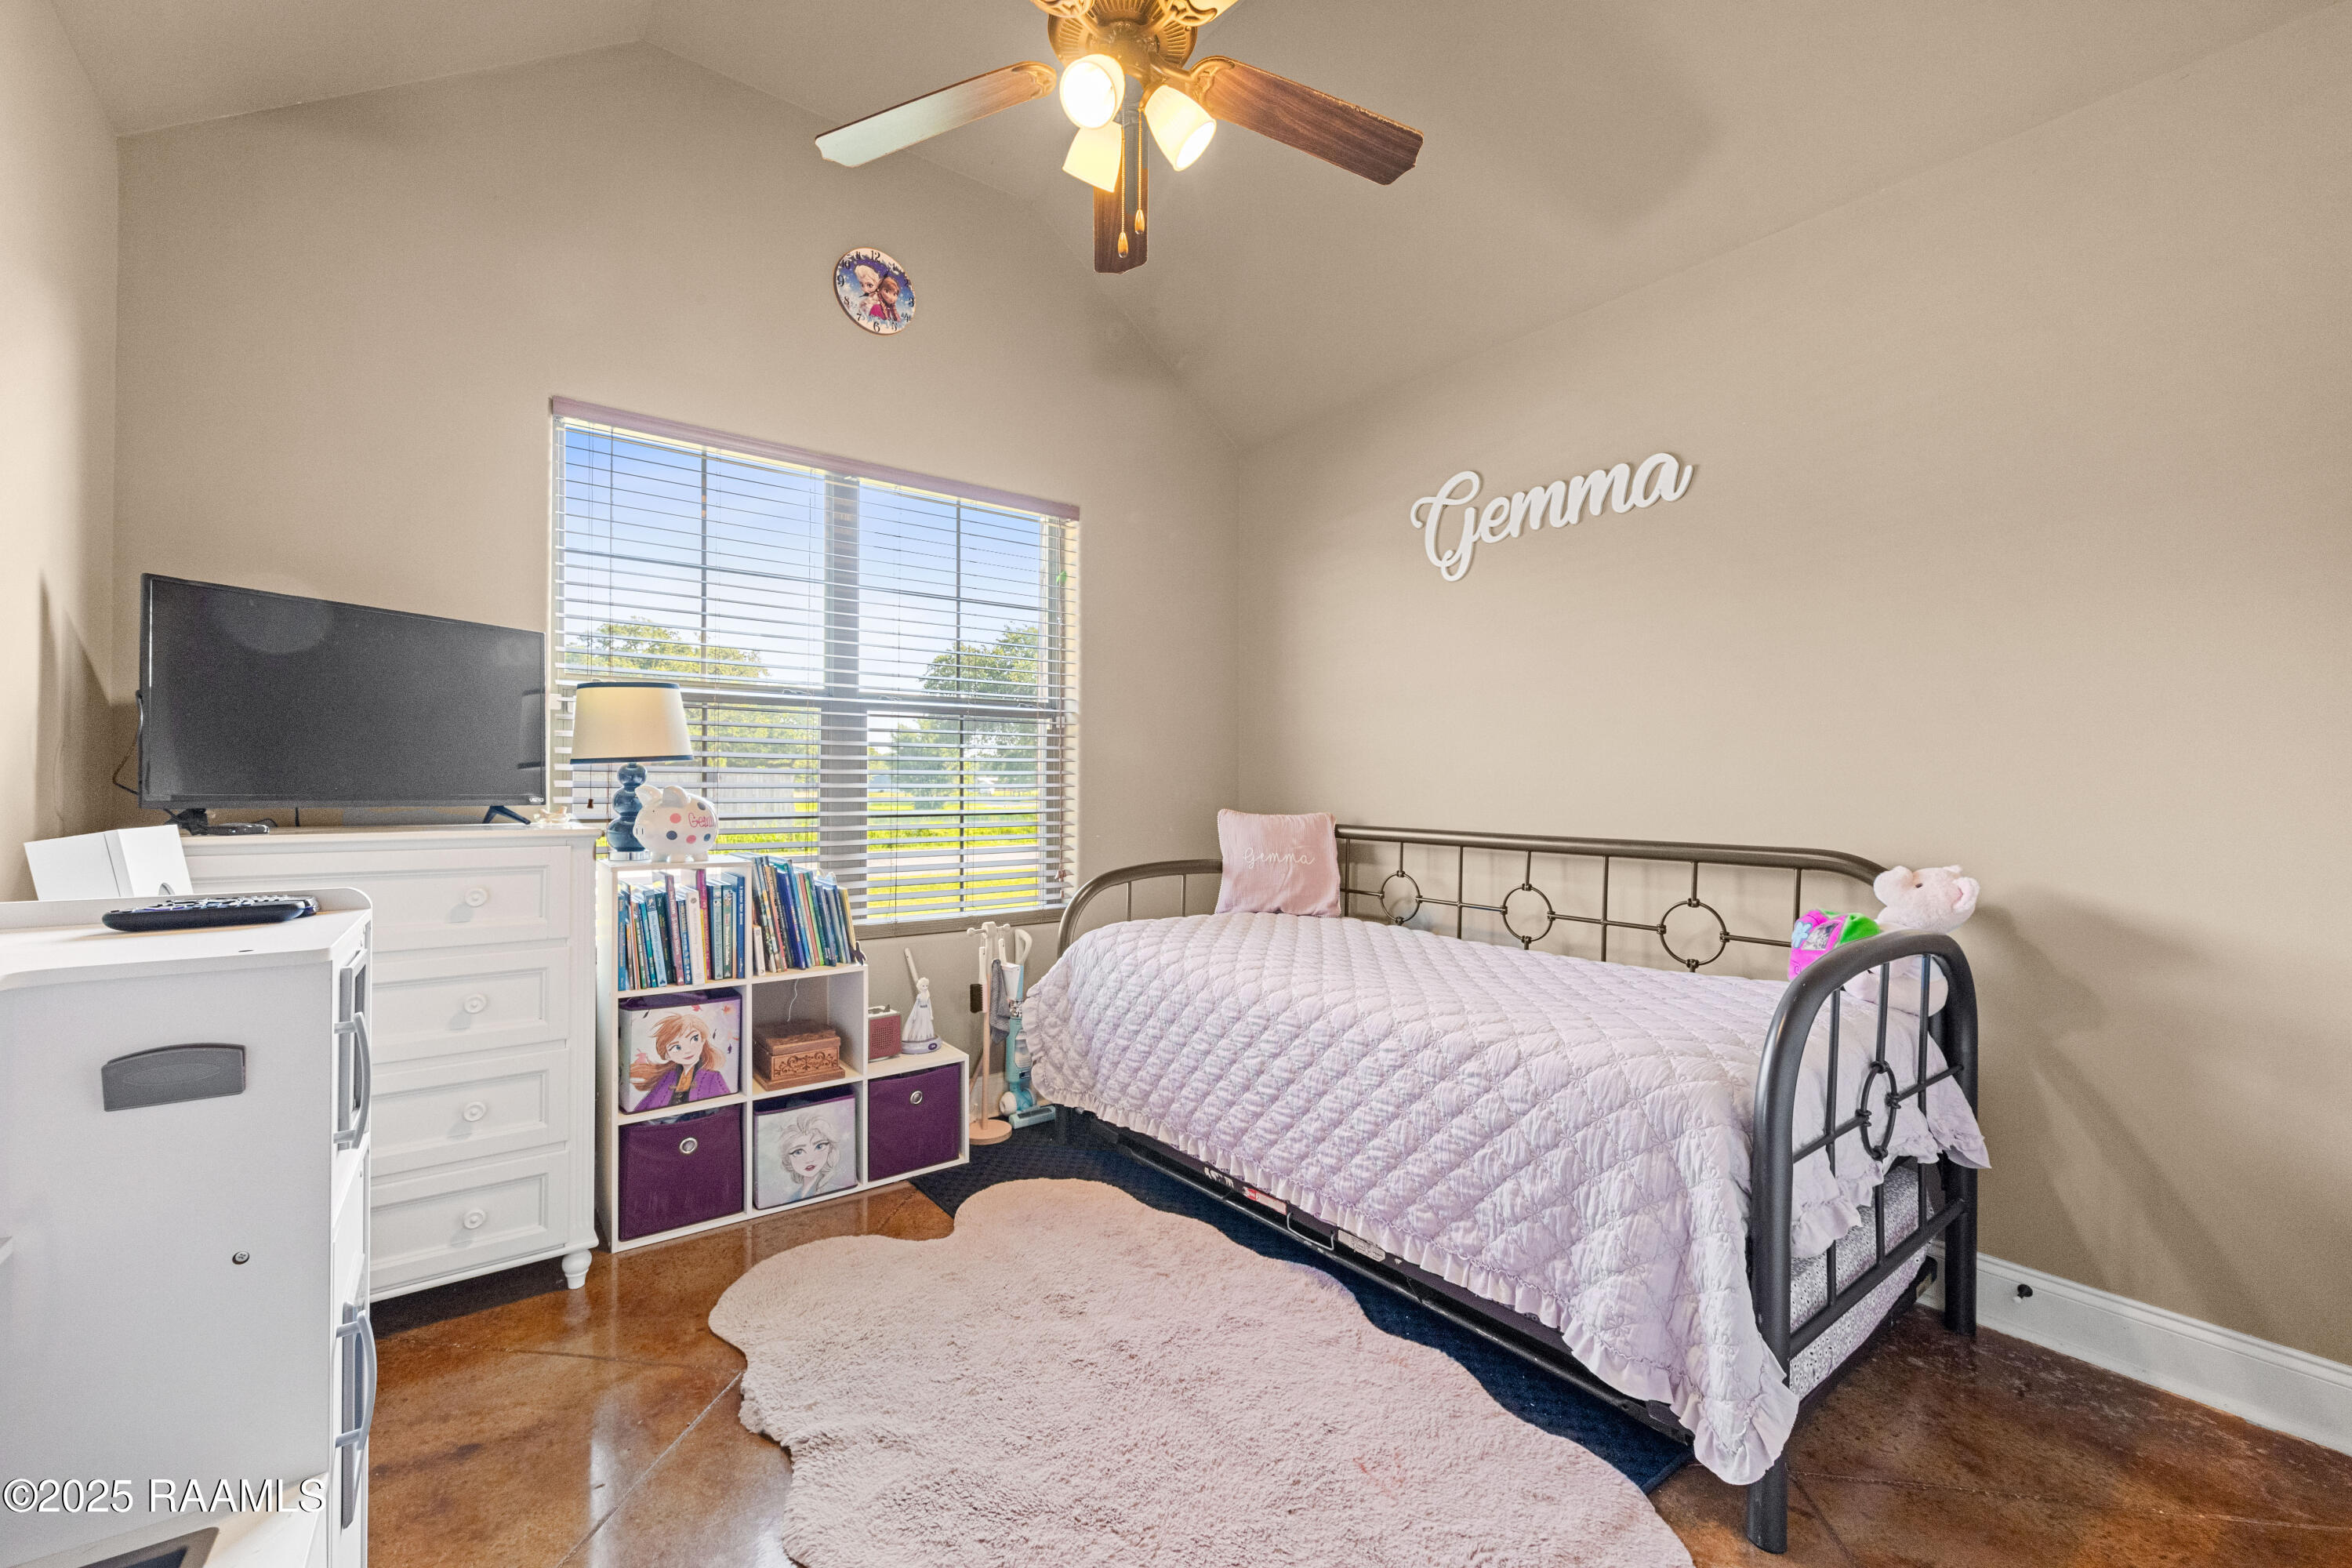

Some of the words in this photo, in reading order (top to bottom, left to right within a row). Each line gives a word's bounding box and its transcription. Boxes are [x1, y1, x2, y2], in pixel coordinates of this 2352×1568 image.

[871, 250, 880, 262] 12
[837, 274, 845, 287] 9
[844, 296, 850, 306] 8
[909, 297, 915, 307] 3
[856, 313, 862, 321] 7
[873, 321, 880, 332] 6
[1410, 452, 1694, 582] Gemma
[1243, 847, 1316, 869] Gemma
